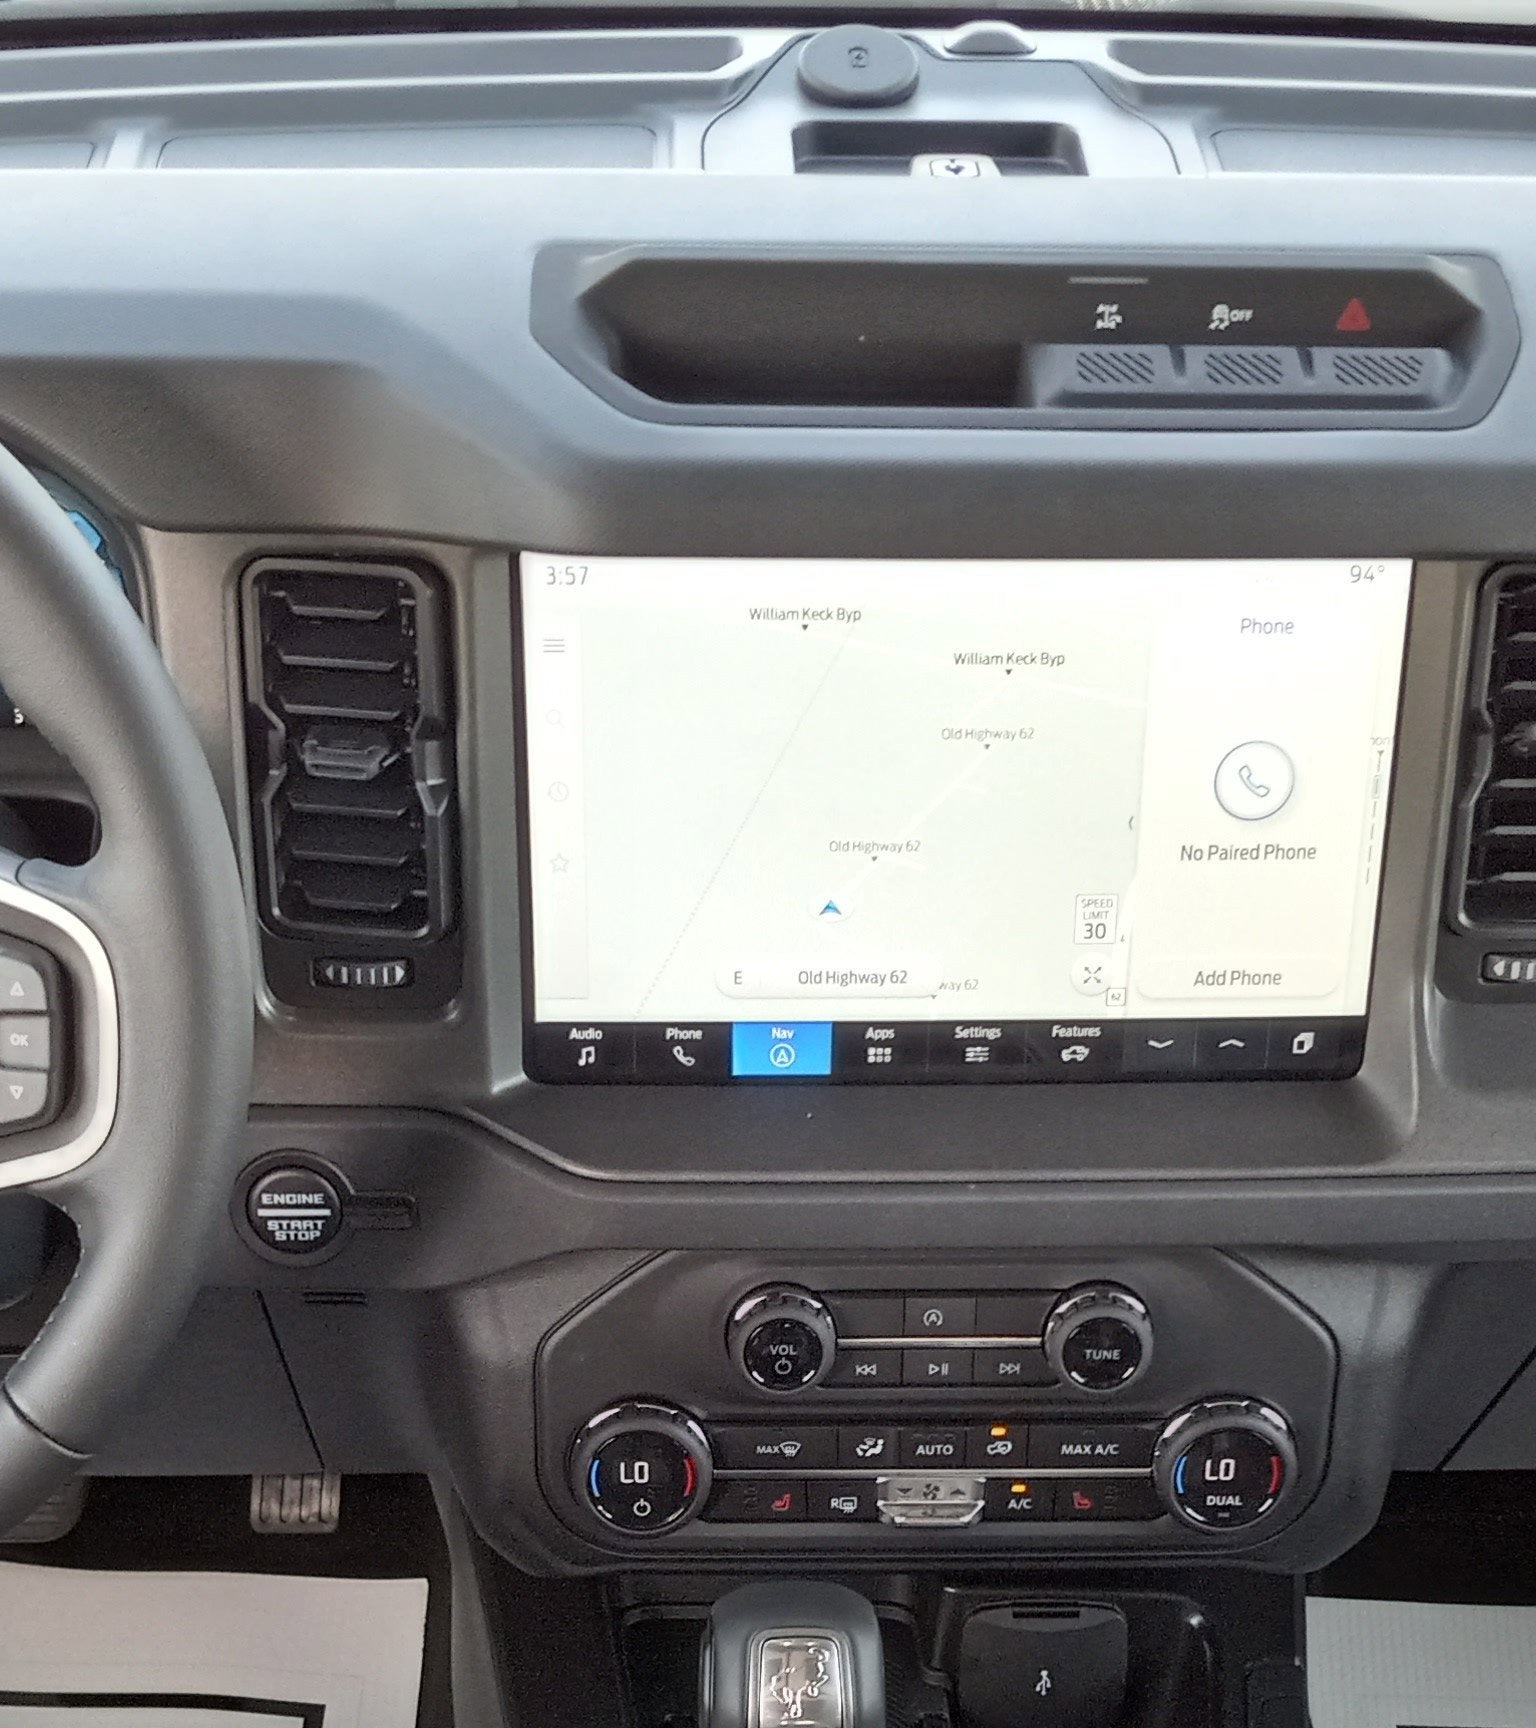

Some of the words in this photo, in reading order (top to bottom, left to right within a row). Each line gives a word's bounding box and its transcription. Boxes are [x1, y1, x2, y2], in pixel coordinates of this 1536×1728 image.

[1230, 309, 1253, 322] OFF
[545, 565, 589, 587] 3:57
[1349, 564, 1386, 585] 94°
[749, 607, 802, 622] William
[802, 607, 833, 622] Keck
[837, 607, 862, 624] Byp
[1241, 618, 1294, 636] Phone
[953, 652, 1004, 666] William
[1006, 652, 1037, 666] Keck
[1040, 652, 1065, 669] Byp
[941, 727, 963, 741] Old
[965, 727, 1017, 743] Highway
[1019, 727, 1035, 741] 62
[829, 840, 850, 853] Old
[852, 840, 904, 856] Highway
[906, 840, 921, 853] 62
[1180, 844, 1204, 862] No
[1207, 844, 1260, 862] Paired
[1263, 844, 1317, 862] Phone
[1081, 898, 1113, 909] SPEED
[1083, 911, 1109, 921] LIMIT
[1083, 922, 1107, 941] 30
[733, 971, 743, 986] E
[798, 970, 823, 986] Old
[826, 970, 886, 989] Highway
[889, 970, 908, 986] 62
[964, 978, 979, 991] 62
[1194, 969, 1229, 988] Add
[1234, 969, 1282, 988] Phone
[570, 1028, 602, 1041] Audio
[666, 1027, 702, 1041] Phone
[771, 1027, 794, 1041] Nav
[865, 1027, 895, 1044] Apps
[954, 1026, 1002, 1043] Settings
[1052, 1025, 1101, 1040] Features
[10, 1034, 29, 1047] OK
[261, 1193, 324, 1205] ENGINE
[267, 1220, 325, 1231] START
[275, 1230, 321, 1241] STOP
[769, 1344, 797, 1357] VOL
[1085, 1348, 1120, 1361] TUNE
[757, 1444, 779, 1455] MAX
[915, 1443, 954, 1457] AUTO
[1061, 1443, 1090, 1456] MAX
[1094, 1442, 1119, 1457] A/C
[620, 1462, 649, 1483] LO
[1205, 1460, 1235, 1481] LO
[1008, 1499, 1032, 1510] A/C
[1206, 1494, 1242, 1506] DUAL
